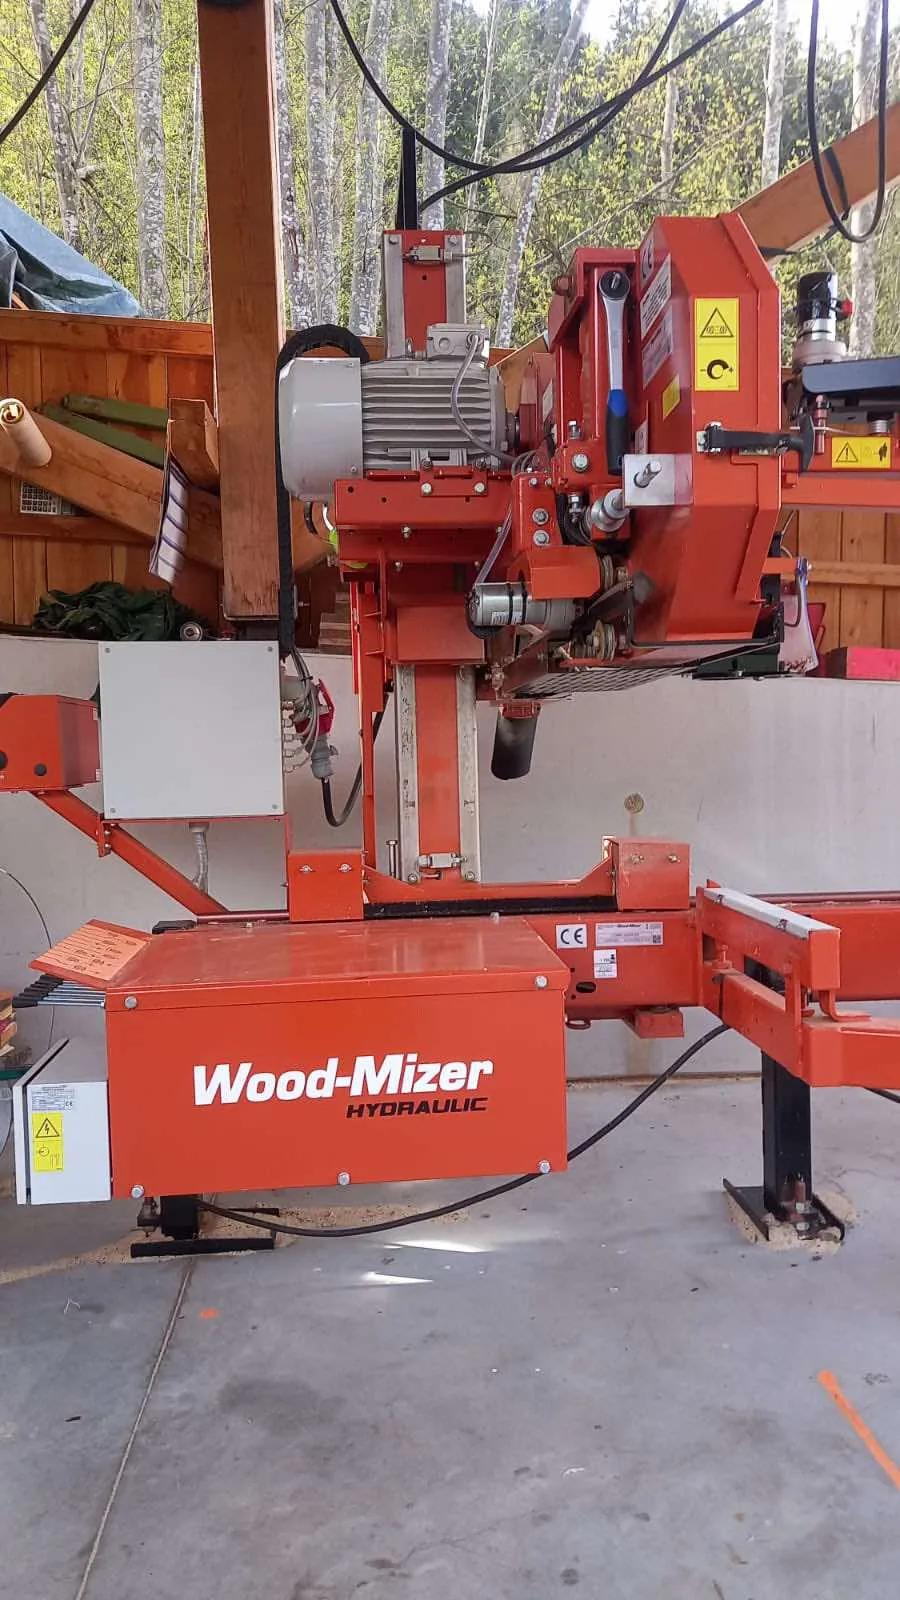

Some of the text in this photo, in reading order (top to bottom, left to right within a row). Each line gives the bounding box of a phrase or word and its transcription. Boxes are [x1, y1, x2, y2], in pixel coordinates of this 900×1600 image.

[560, 928, 583, 944] CE
[193, 1053, 494, 1106] Wood-Mizer
[346, 1097, 489, 1118] HYDRAULIC
